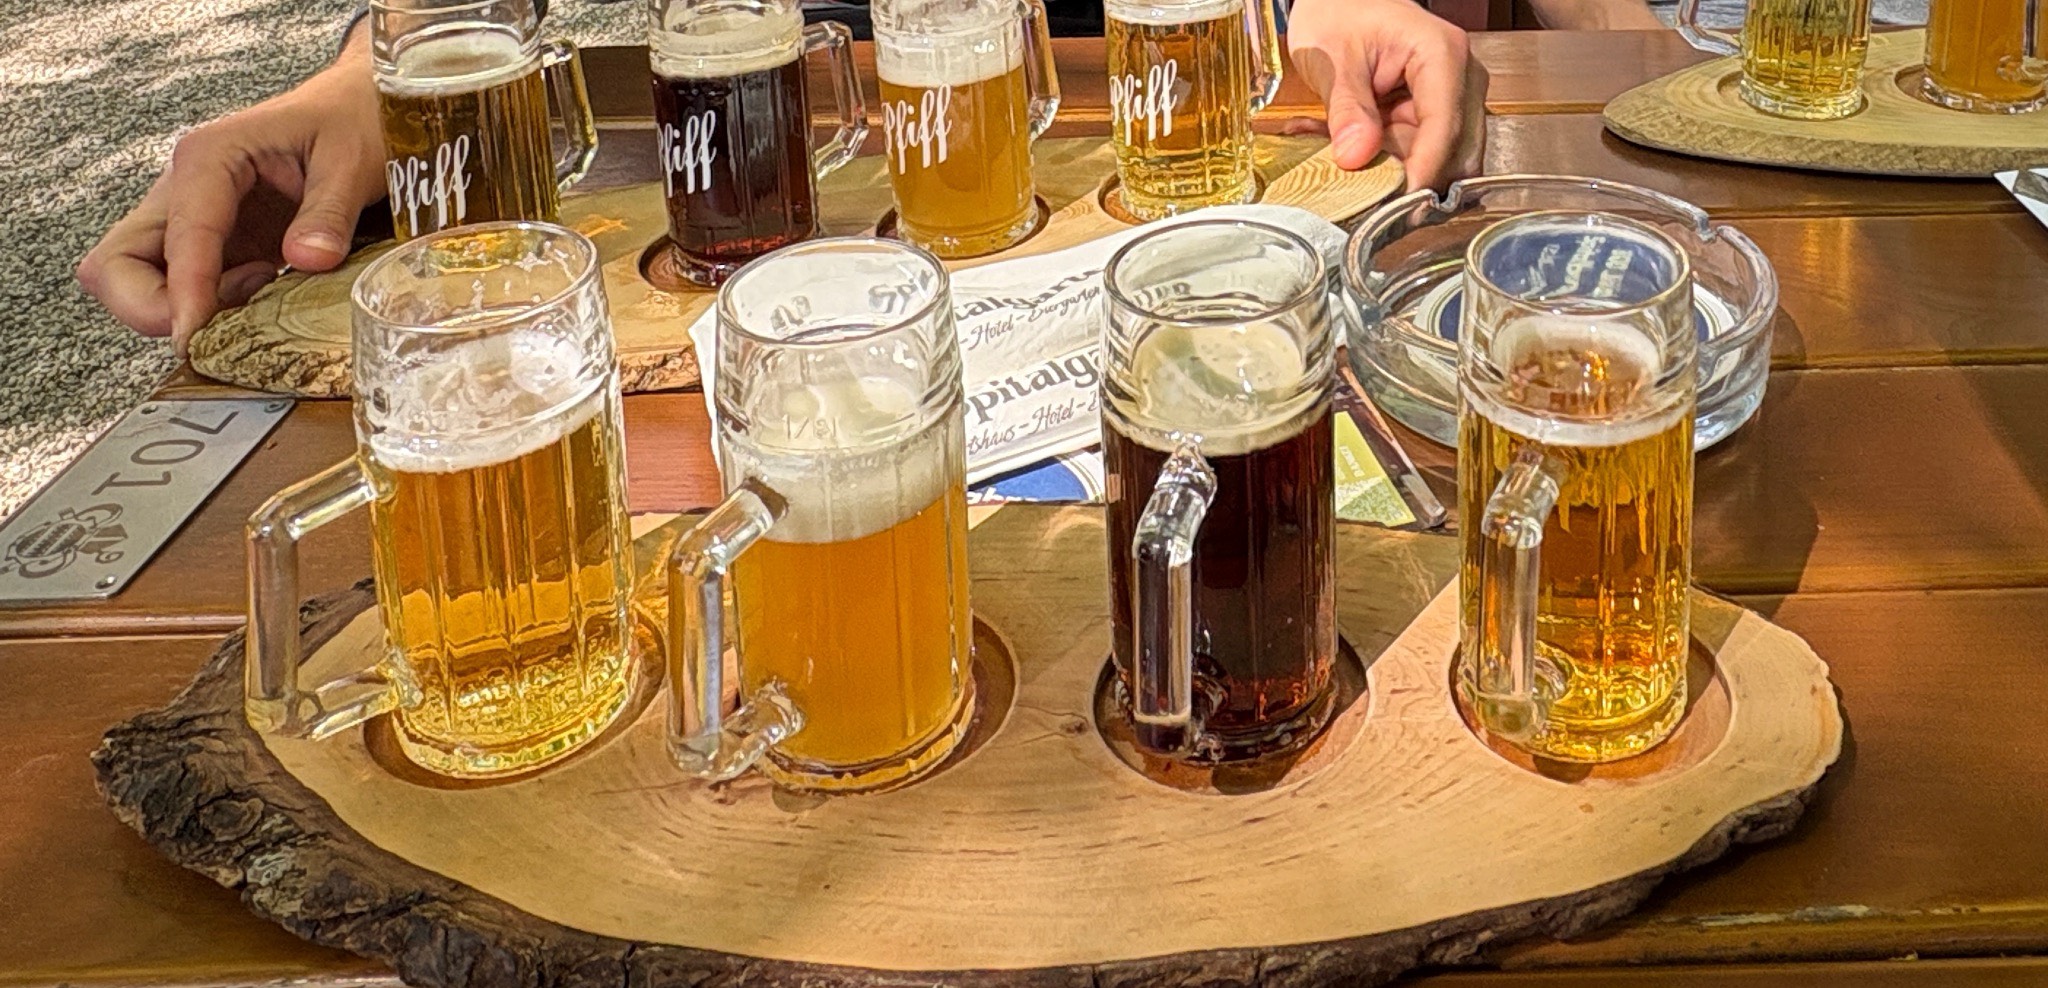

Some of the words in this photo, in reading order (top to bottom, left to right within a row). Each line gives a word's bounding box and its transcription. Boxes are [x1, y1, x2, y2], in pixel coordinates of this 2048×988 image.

[881, 83, 952, 175] Pfiff
[1109, 58, 1178, 147] Pfiff
[385, 134, 472, 237] Pfiff
[967, 314, 1014, 351] Hotel
[91, 411, 239, 496] 701
[1027, 397, 1074, 436] Hotel
